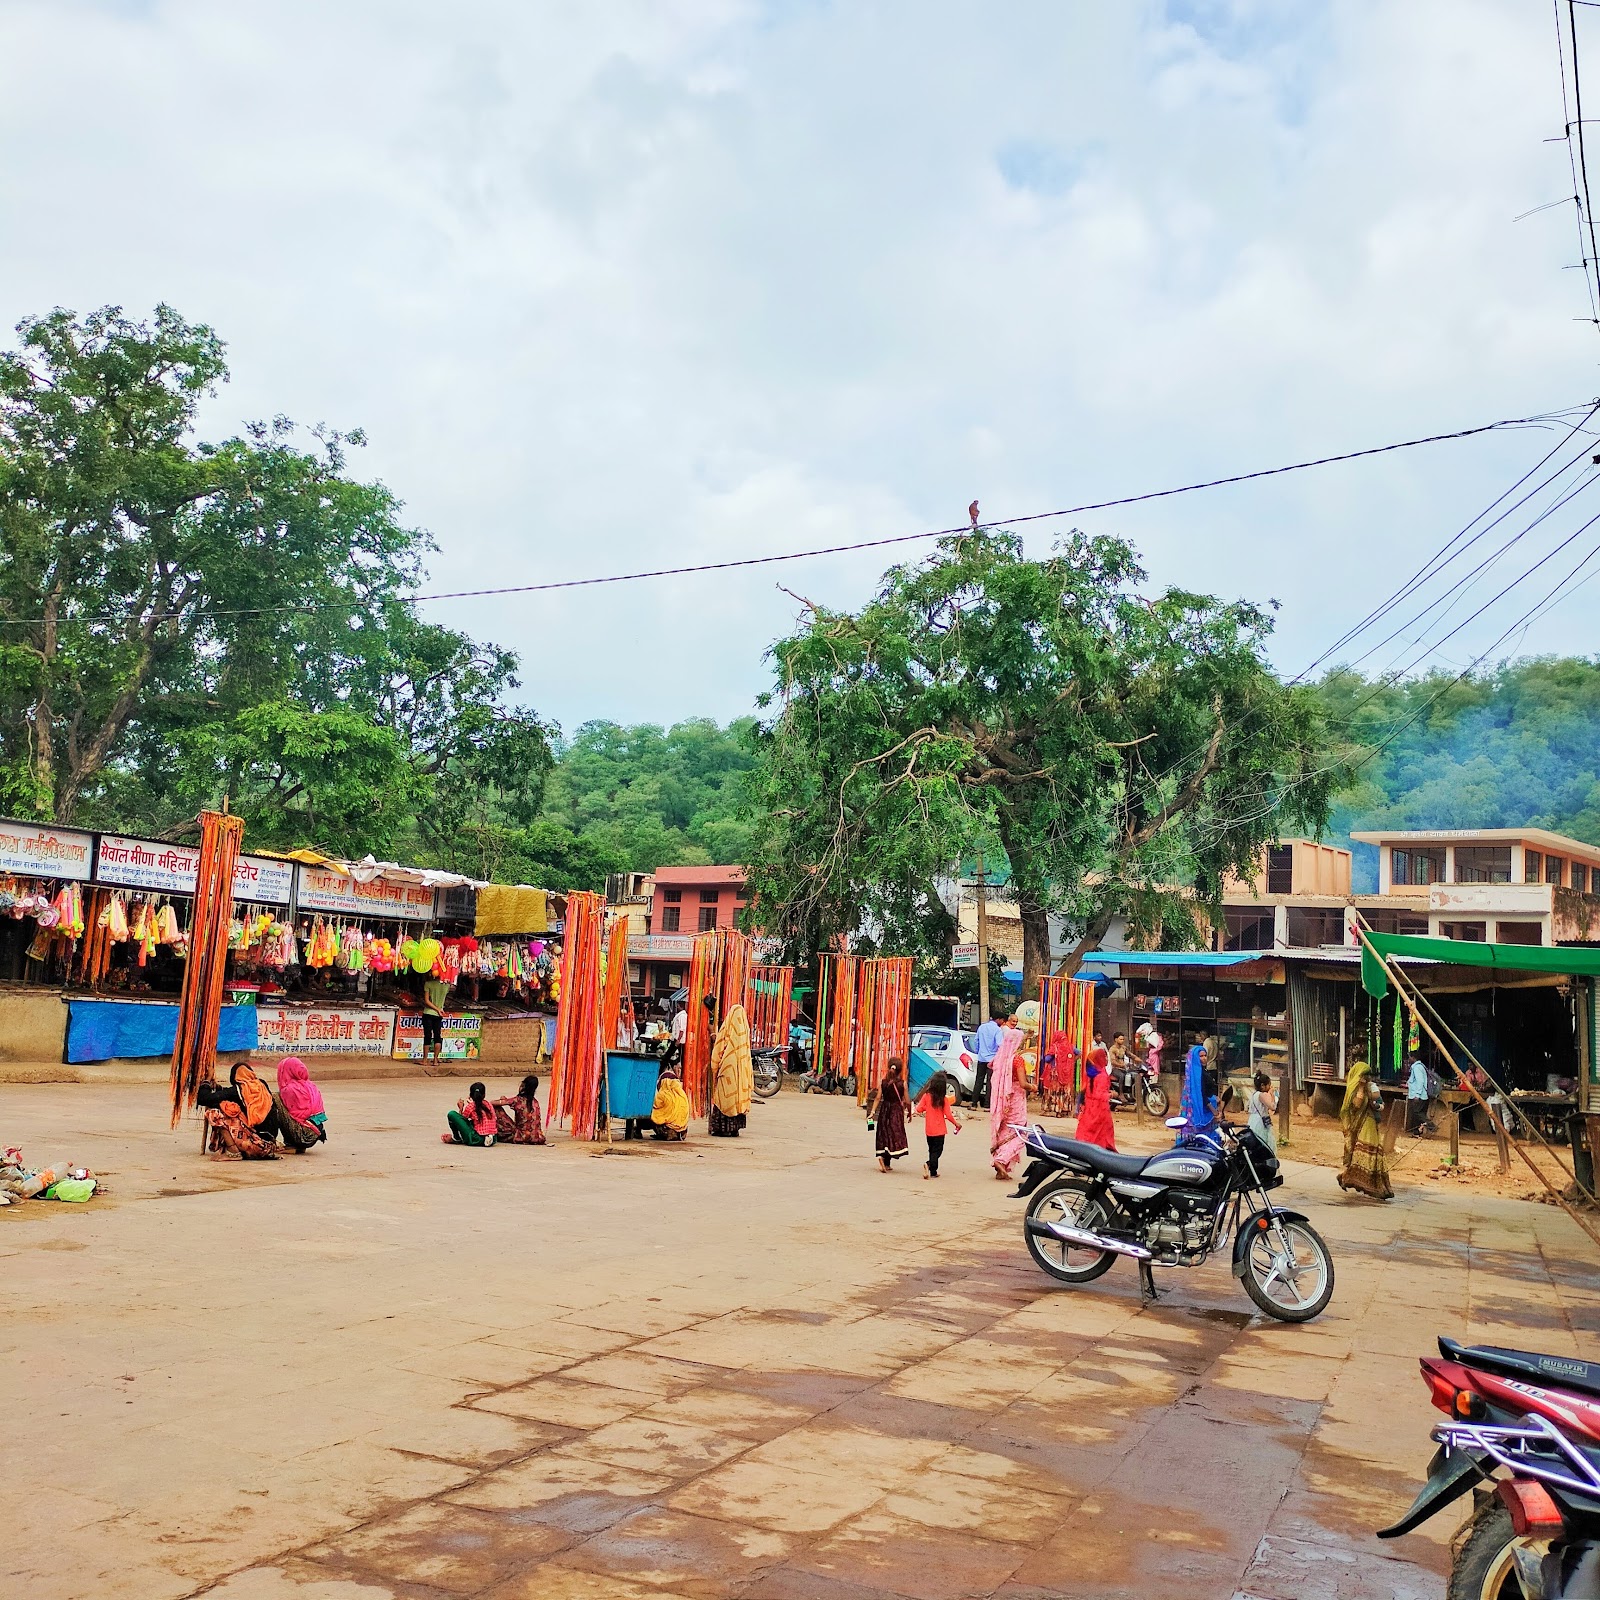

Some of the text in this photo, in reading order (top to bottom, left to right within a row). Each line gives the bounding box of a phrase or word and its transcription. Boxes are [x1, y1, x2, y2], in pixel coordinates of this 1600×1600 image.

[101, 840, 129, 863] मेवाल
[131, 845, 156, 867] मीणा
[158, 850, 193, 873] महिला
[954, 946, 977, 954] ASHOKA
[1186, 1166, 1204, 1174] Hero
[1543, 1359, 1584, 1373] MUSAFIR
